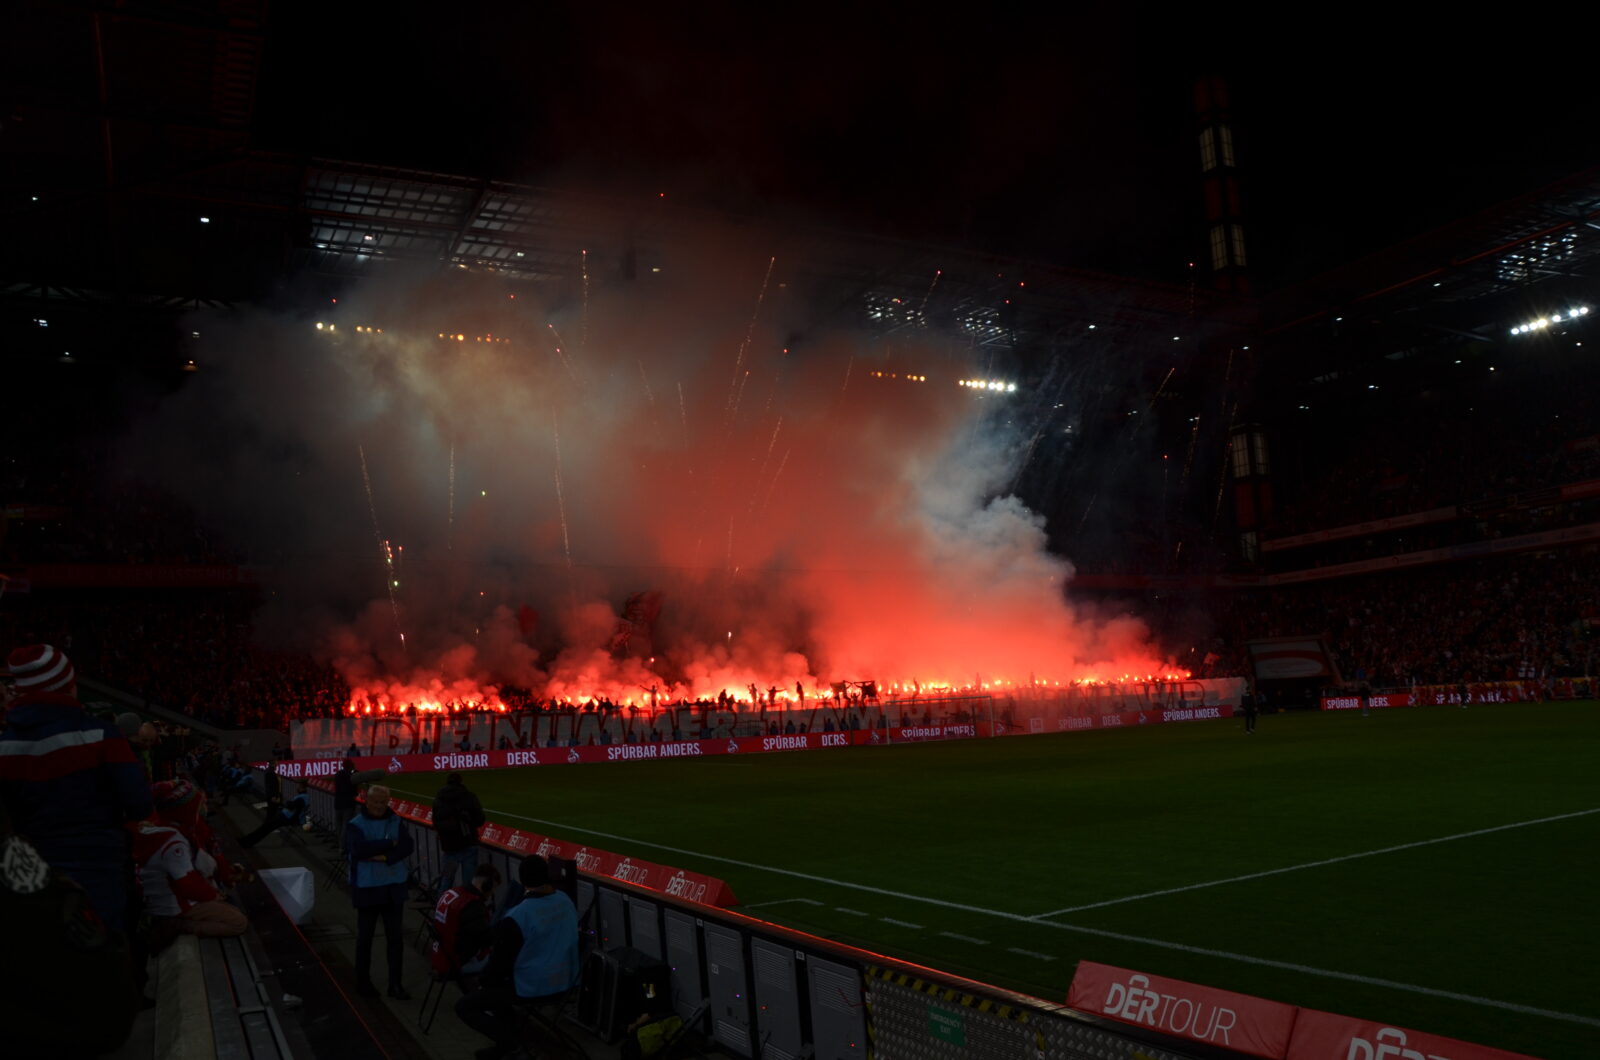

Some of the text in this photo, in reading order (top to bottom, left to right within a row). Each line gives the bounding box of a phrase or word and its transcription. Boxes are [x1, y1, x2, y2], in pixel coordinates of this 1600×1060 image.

[1058, 716, 1092, 729] SPÜRBAR
[1163, 708, 1194, 722] SPÜRBAR
[607, 742, 703, 760] SPÜRBAR ANDERS.
[763, 735, 807, 751] SPÜRBAR
[433, 752, 489, 770] SPÜRBAR
[507, 751, 540, 766] DERS.
[665, 870, 706, 902] DERTOUR
[1103, 974, 1237, 1046] DERTOUR
